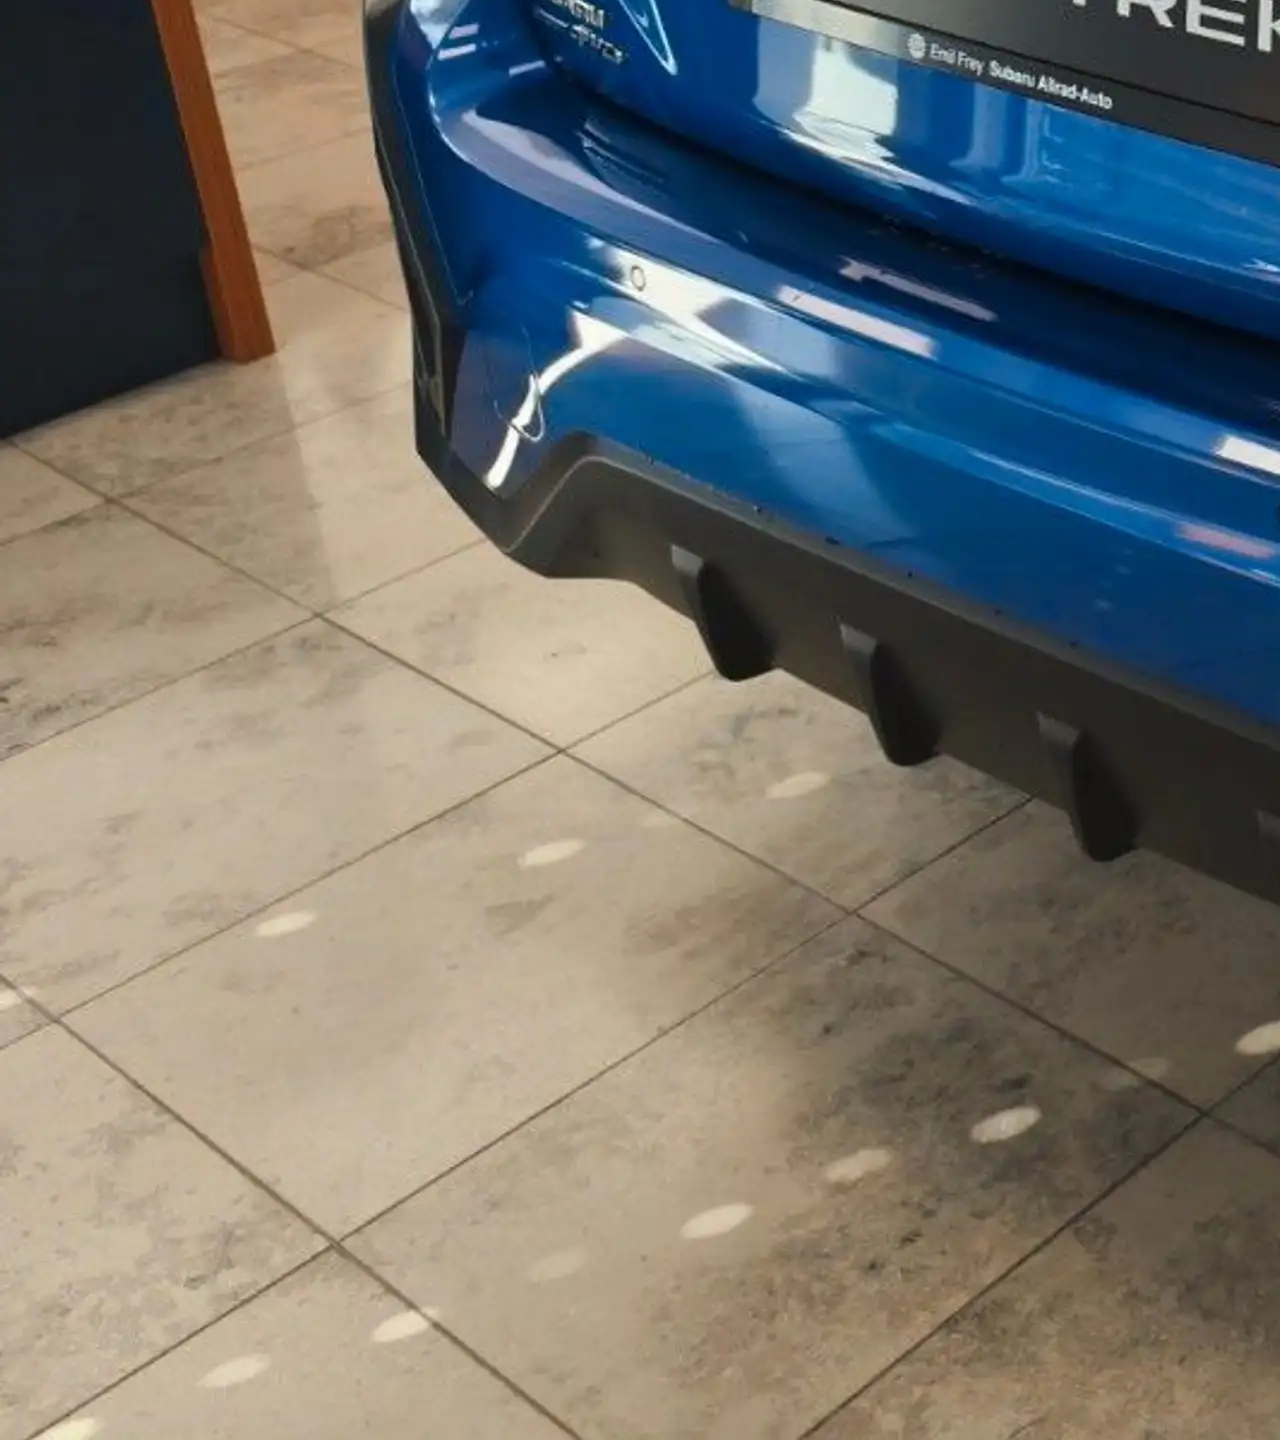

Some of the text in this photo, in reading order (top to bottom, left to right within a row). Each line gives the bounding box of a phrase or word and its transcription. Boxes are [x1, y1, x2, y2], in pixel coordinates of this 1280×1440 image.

[930, 43, 1114, 110] Emil Frey Subaru Allrad-Auto
